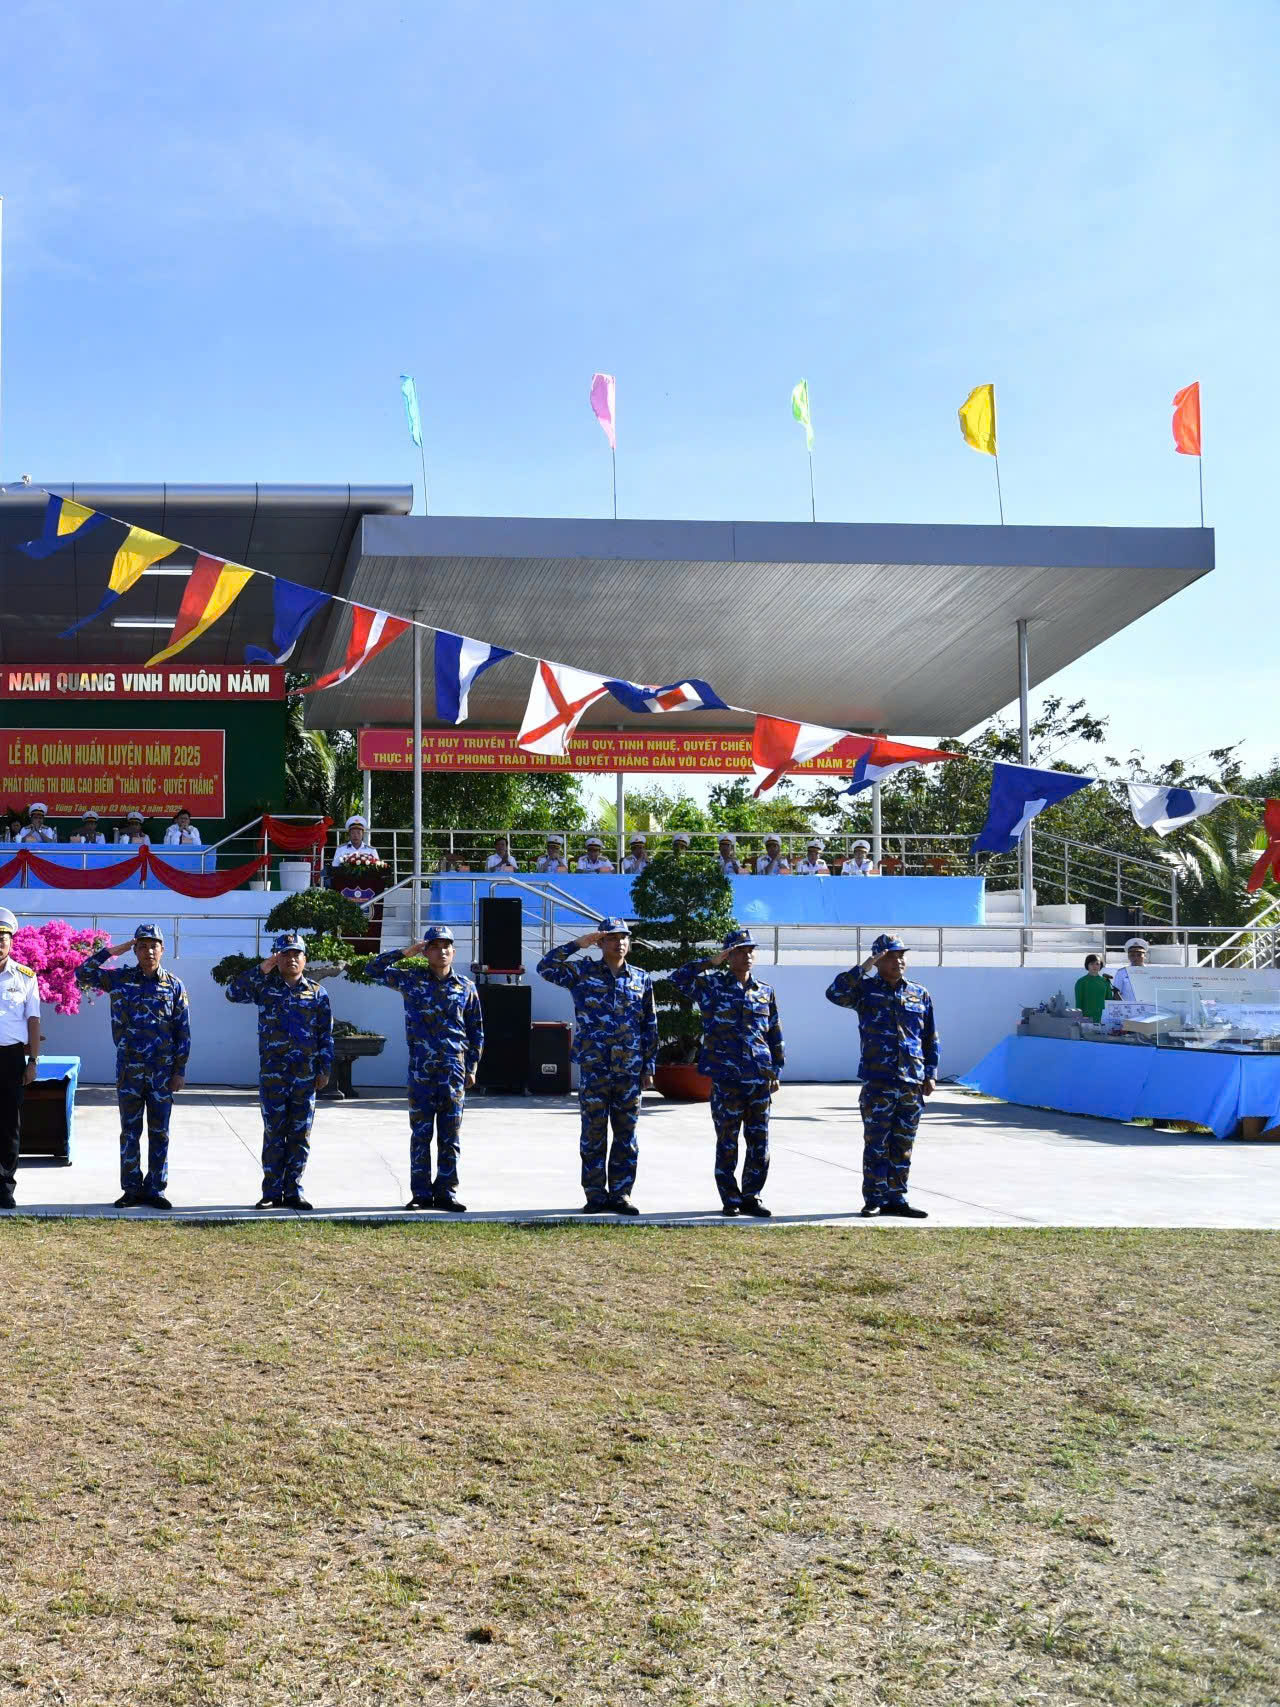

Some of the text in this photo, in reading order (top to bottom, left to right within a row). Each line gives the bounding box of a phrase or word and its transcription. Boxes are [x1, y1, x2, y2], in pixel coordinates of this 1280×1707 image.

[9, 673, 50, 692] NAM
[57, 673, 115, 693] QUANG
[122, 673, 162, 692] VINH
[169, 669, 220, 692] MUÔN
[228, 669, 269, 692] NĂM
[9, 737, 200, 769] LỄ RA QUÂN HUẤN LUYỆN NĂM 2025
[407, 736, 435, 747] PÁT
[438, 738, 459, 748] HUY
[463, 736, 505, 748] TRUYỀN
[592, 740, 615, 751] QUY,
[619, 740, 643, 750] TINH
[647, 739, 679, 752] NHUỆ,
[683, 737, 717, 751] QUYẾT
[721, 739, 752, 751] CHIẾN
[373, 753, 401, 765] THỰC
[405, 754, 431, 764] HN
[434, 751, 454, 764] TỐT
[457, 754, 494, 764] PHONG
[499, 753, 526, 764] TRÀO
[530, 755, 547, 765] THI
[551, 755, 571, 765] ĐUA
[575, 754, 609, 766] QUYẾT
[613, 753, 648, 766] THẮNG
[653, 753, 675, 766] GẮN
[679, 755, 696, 766] VỚI
[700, 755, 721, 766] CÁC
[817, 757, 842, 769] NĂM
[3, 774, 22, 793] PHÁT
[24, 774, 44, 796] ĐỘNG
[47, 777, 58, 793] THI
[61, 777, 75, 793] ĐUA
[78, 777, 92, 793] CAO
[95, 772, 114, 793] ĐIỂM
[142, 773, 157, 794] TỐC
[163, 773, 187, 796] QUYẾT
[55, 804, 72, 813] Vũng
[109, 804, 118, 812] 03
[141, 804, 146, 812] 3
